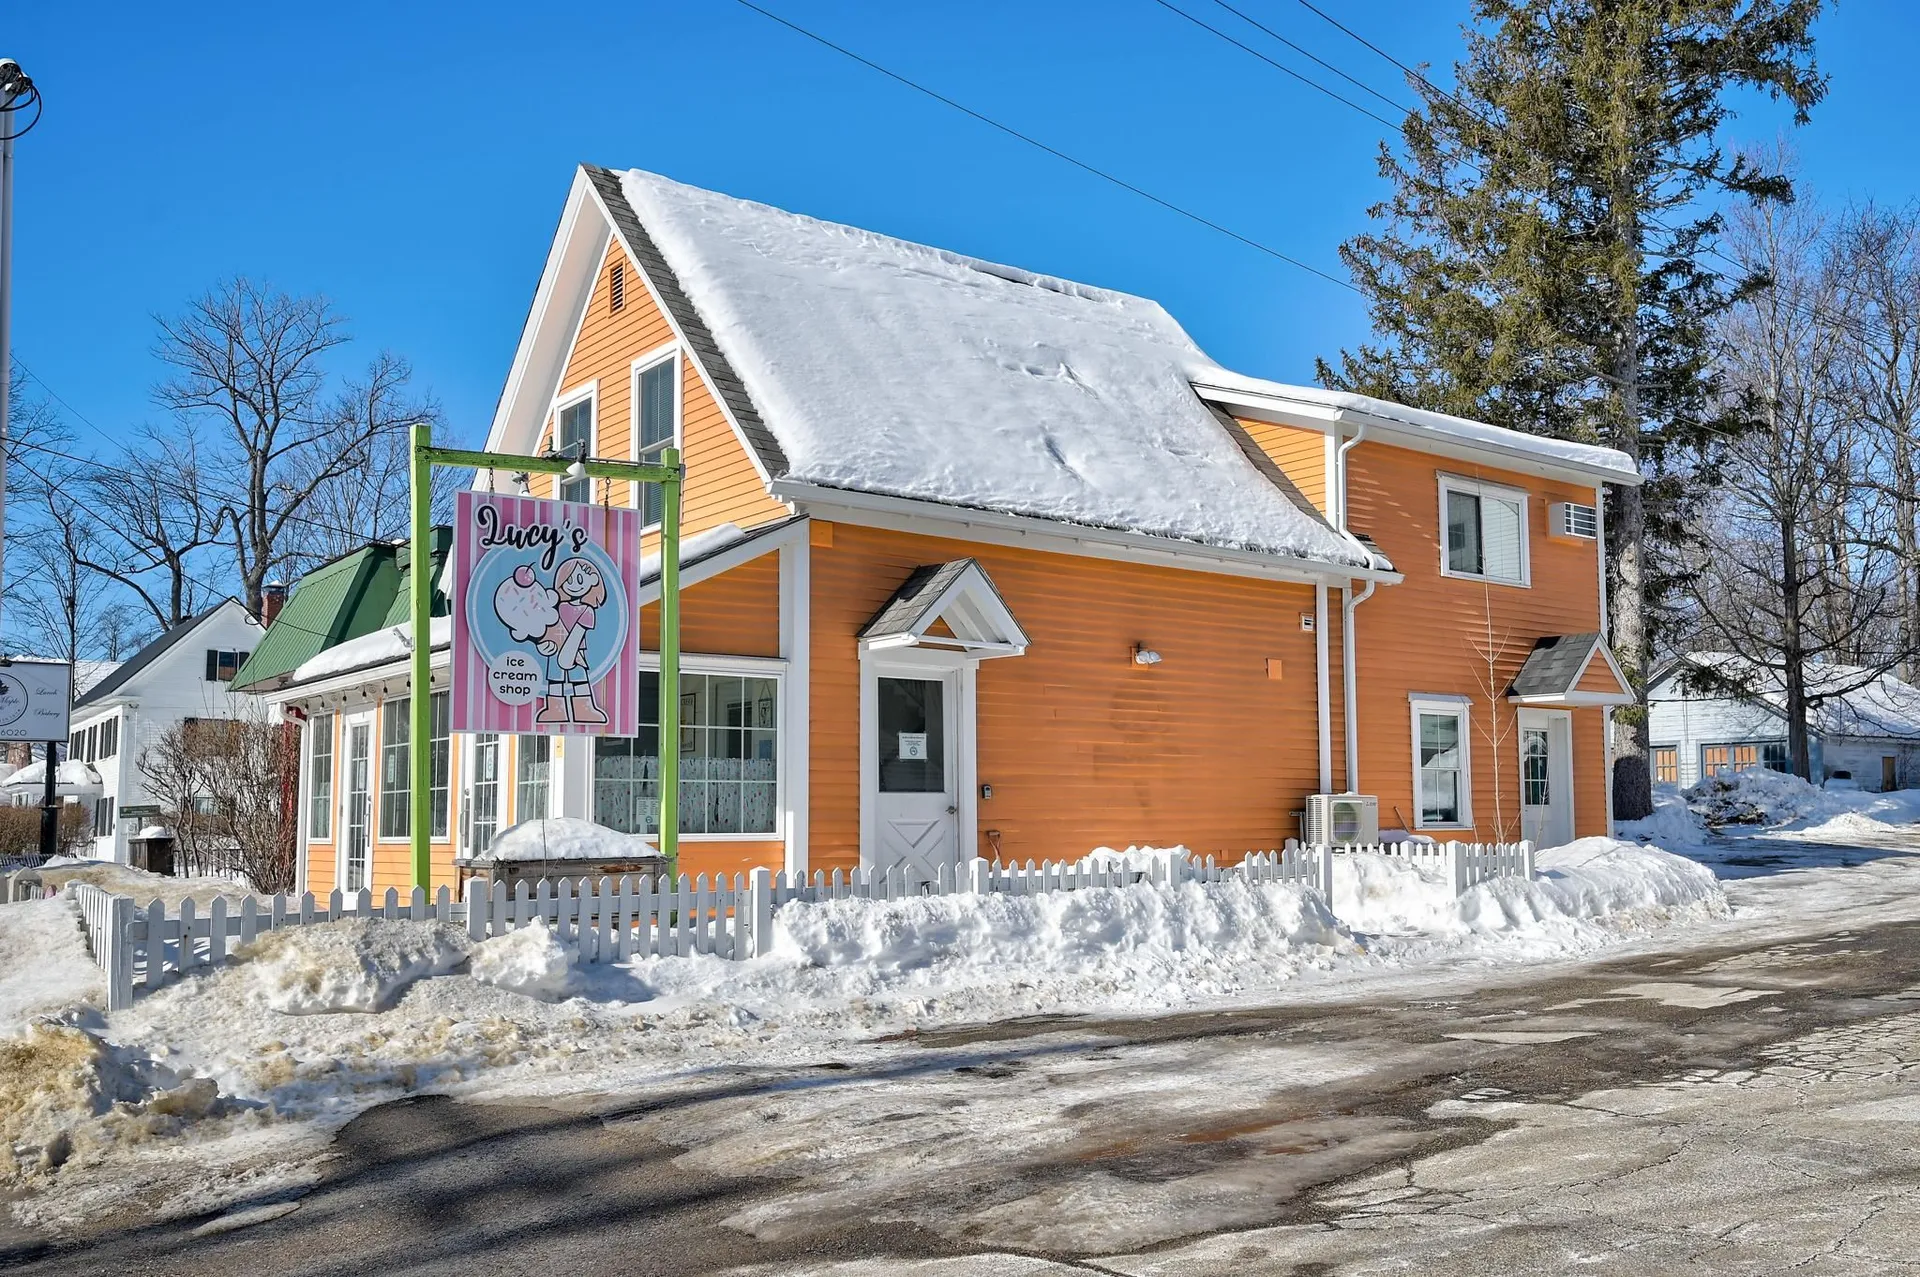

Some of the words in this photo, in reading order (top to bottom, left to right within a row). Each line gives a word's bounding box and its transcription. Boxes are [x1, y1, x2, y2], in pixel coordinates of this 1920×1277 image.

[477, 505, 588, 571] Lucy's
[506, 656, 525, 667] ice
[493, 671, 538, 682] cream
[499, 684, 531, 696] shop
